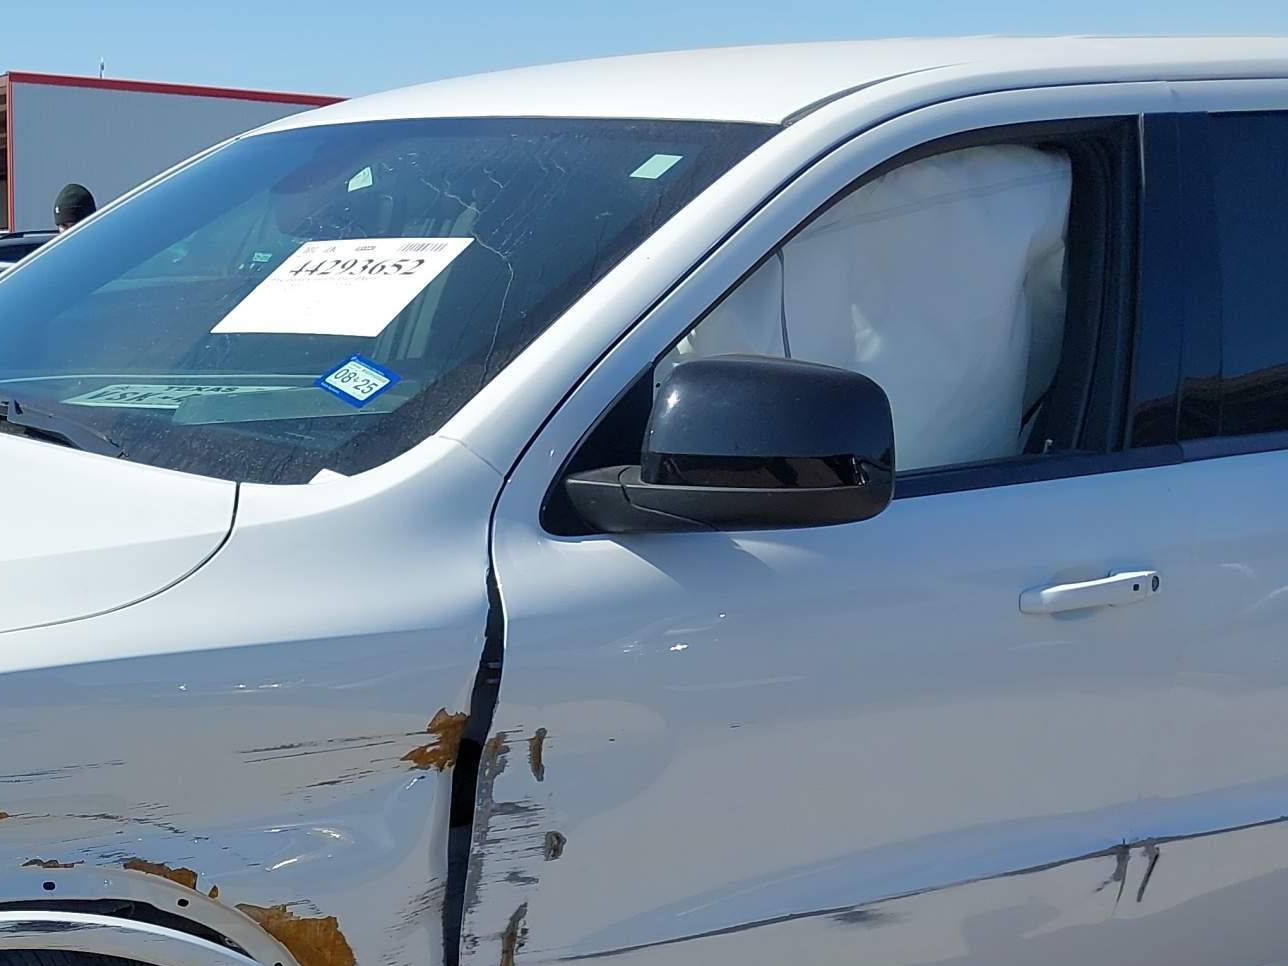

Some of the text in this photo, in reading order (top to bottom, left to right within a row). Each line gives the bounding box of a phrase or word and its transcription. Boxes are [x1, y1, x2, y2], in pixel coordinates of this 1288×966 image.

[289, 258, 426, 276] 44293652
[334, 368, 357, 384] 08
[352, 378, 379, 394] 25
